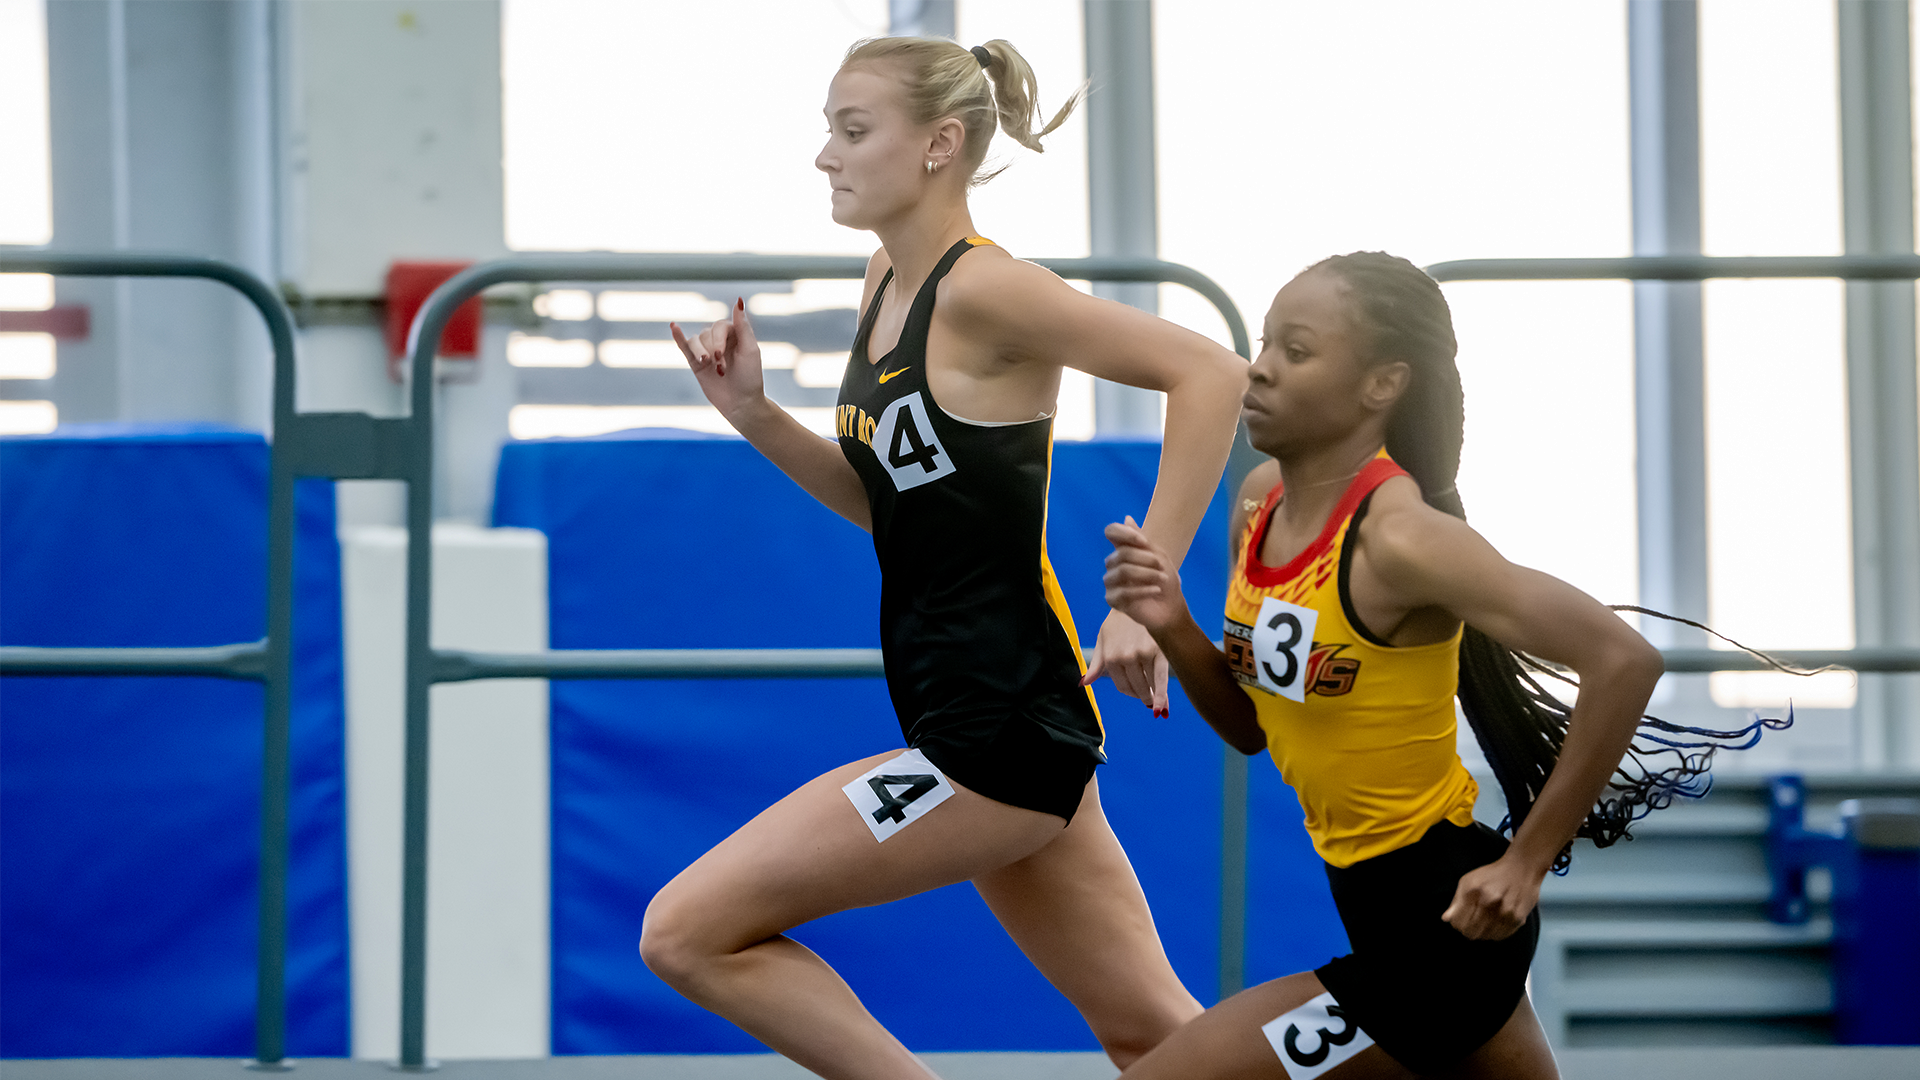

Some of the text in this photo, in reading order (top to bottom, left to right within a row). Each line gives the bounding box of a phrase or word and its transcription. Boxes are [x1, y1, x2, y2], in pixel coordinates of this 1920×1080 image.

[858, 408, 877, 450] RO
[888, 404, 940, 474] 4
[1261, 612, 1303, 688] 3
[866, 774, 940, 825] 4
[1284, 1004, 1358, 1068] 3
